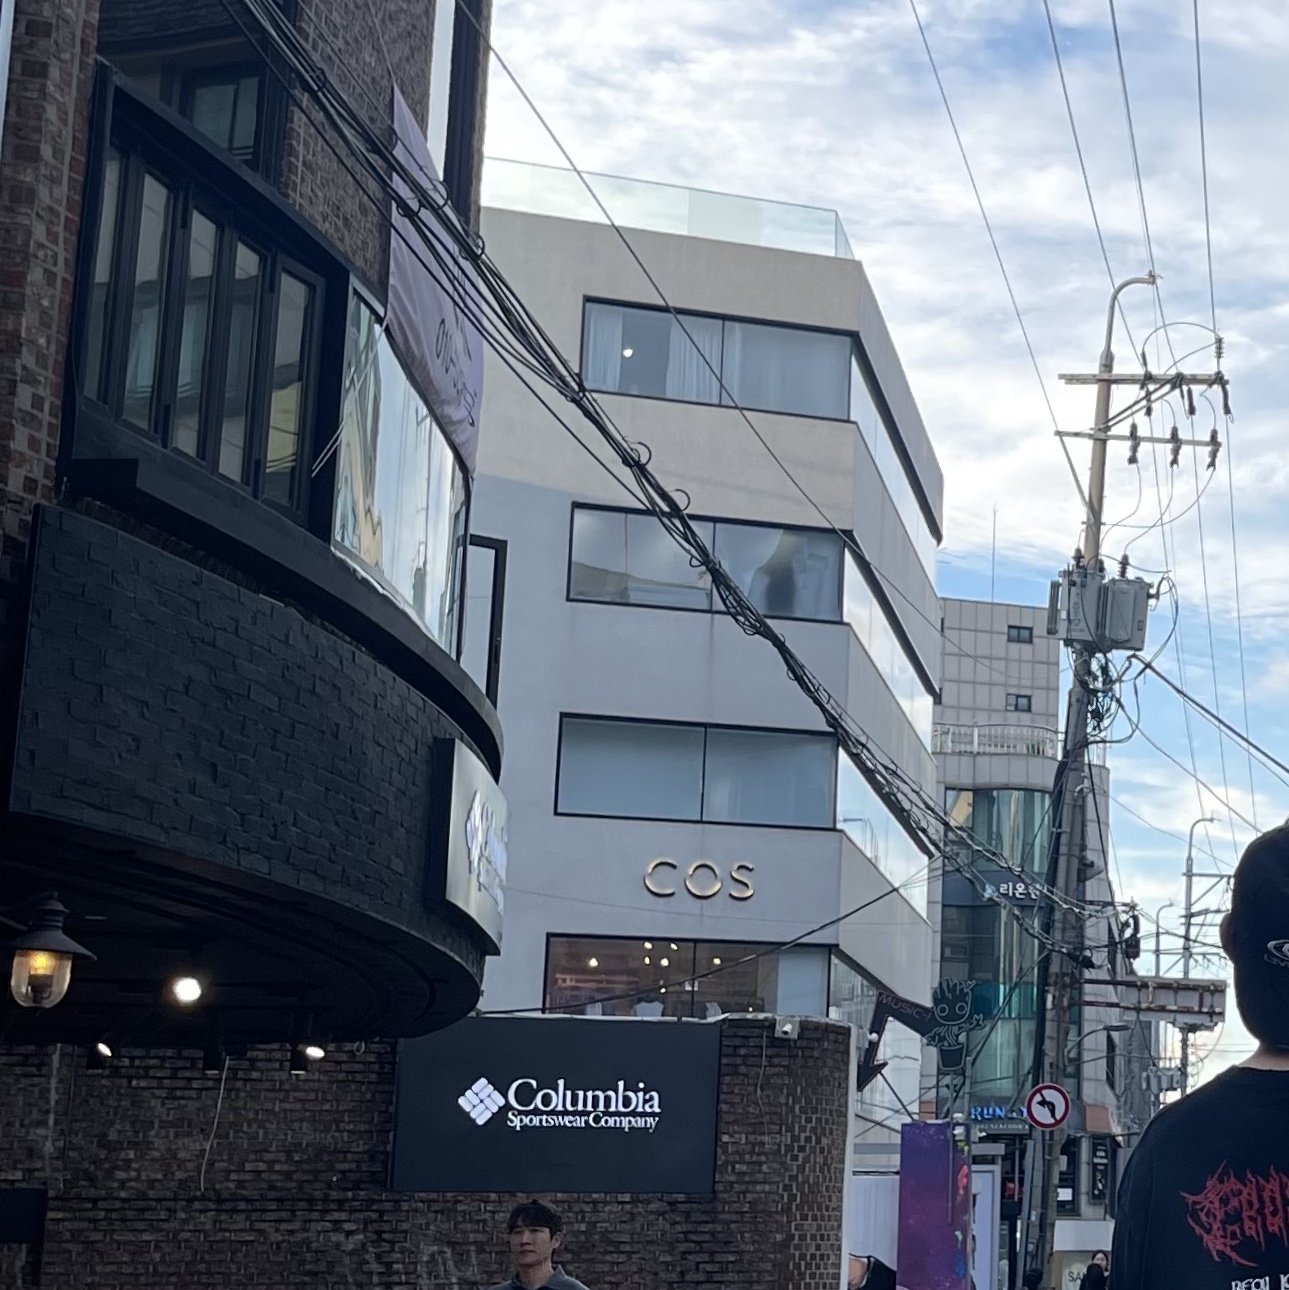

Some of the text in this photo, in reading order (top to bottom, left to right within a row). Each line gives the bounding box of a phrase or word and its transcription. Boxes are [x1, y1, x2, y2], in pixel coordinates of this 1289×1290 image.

[643, 856, 756, 901] COS
[506, 1077, 662, 1113] Columbia
[506, 1110, 660, 1133] Sportswear Company
